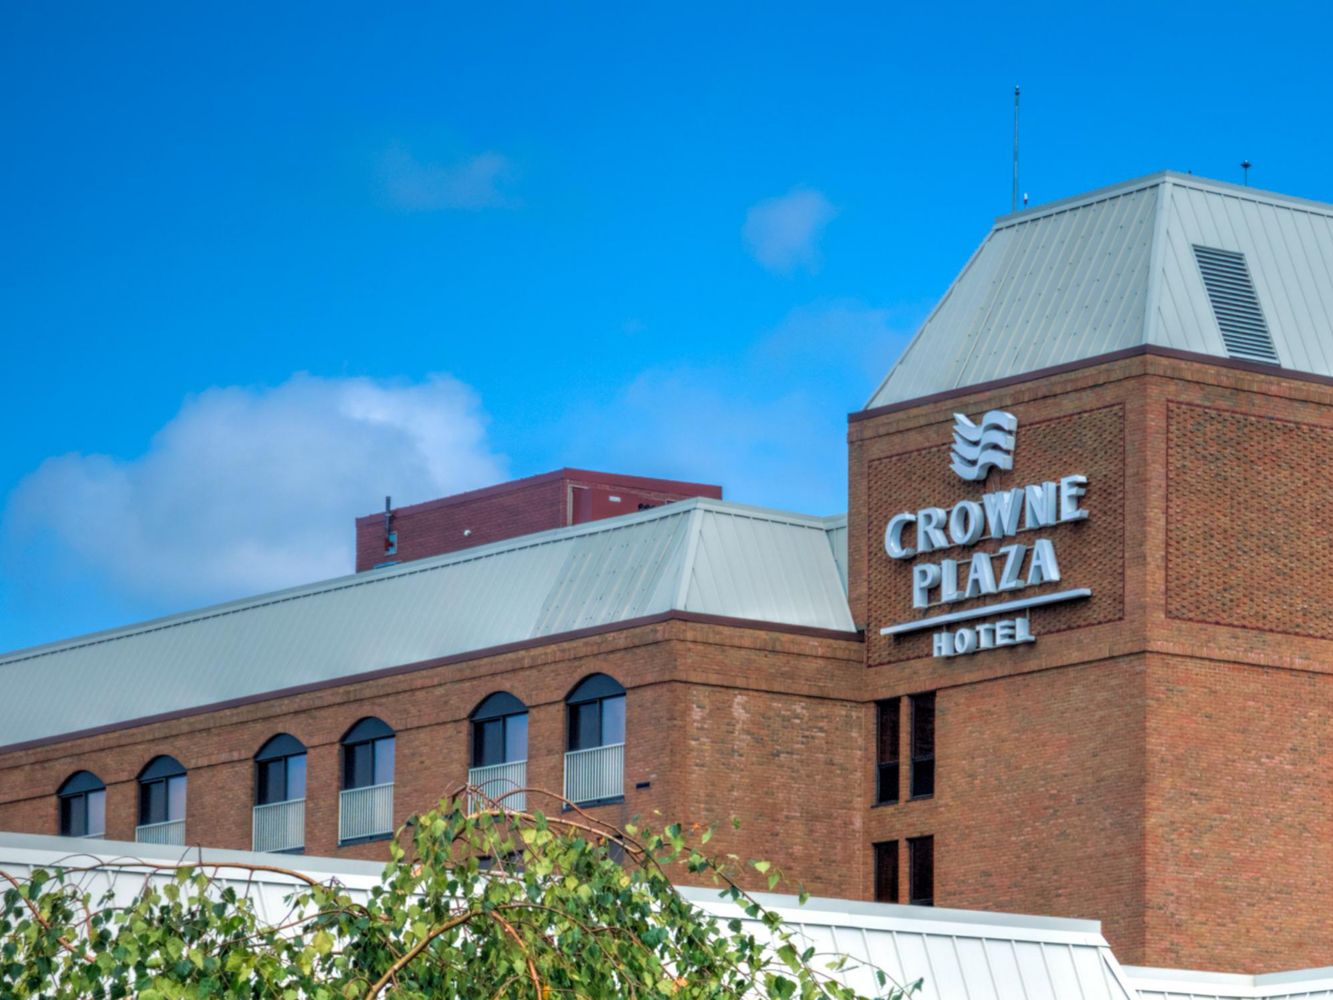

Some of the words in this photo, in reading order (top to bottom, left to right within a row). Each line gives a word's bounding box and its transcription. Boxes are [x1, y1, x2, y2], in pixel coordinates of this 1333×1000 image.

[884, 474, 1089, 560] CROWNE
[912, 538, 1061, 609] PLAZA
[932, 617, 1036, 657] HOTEL
